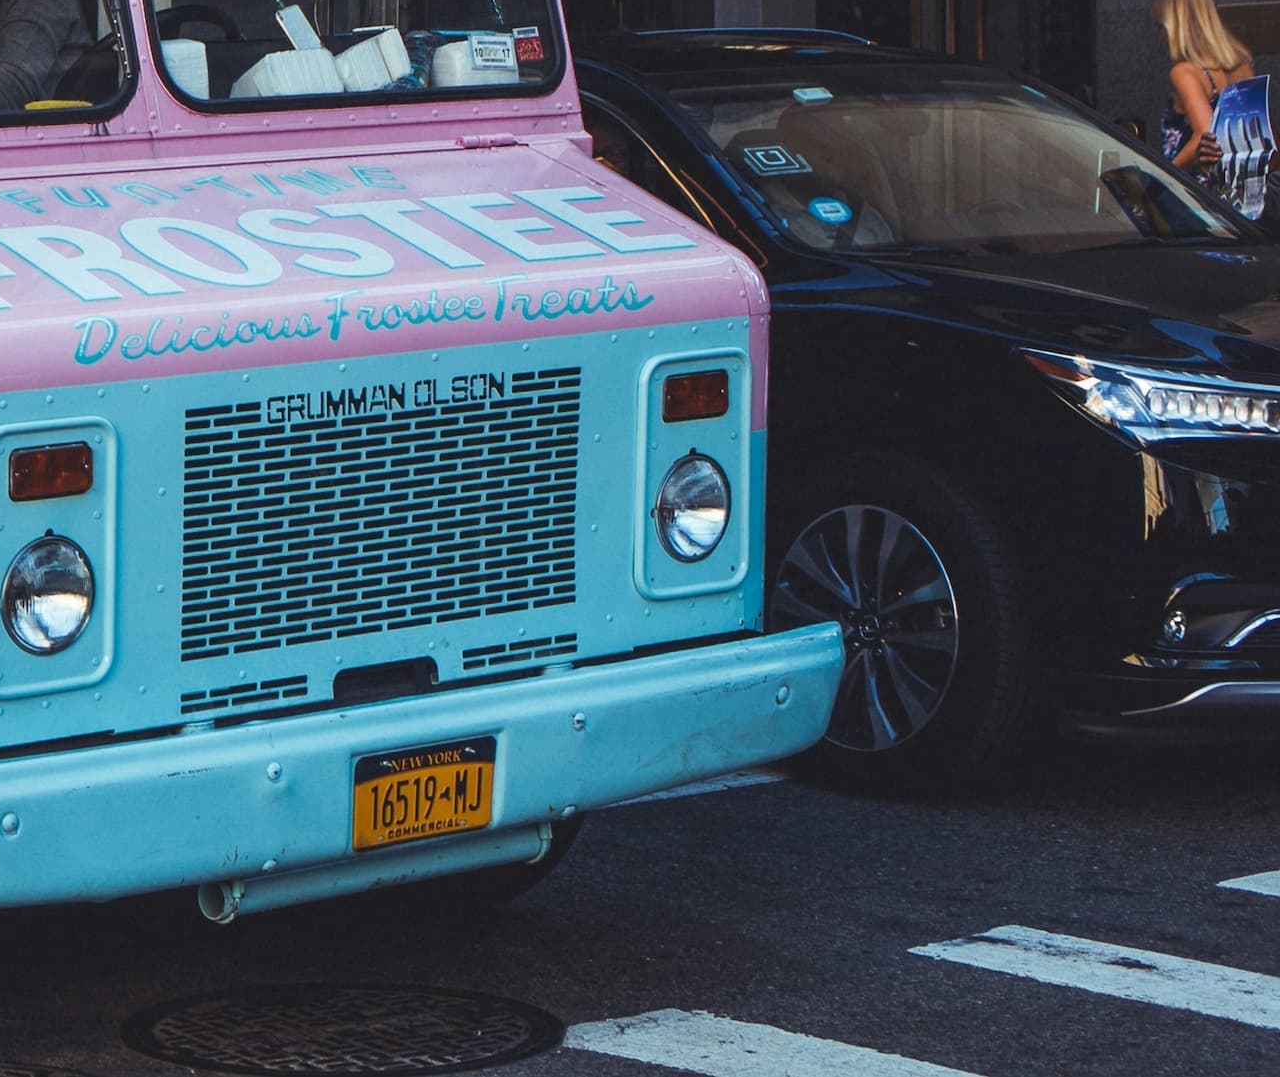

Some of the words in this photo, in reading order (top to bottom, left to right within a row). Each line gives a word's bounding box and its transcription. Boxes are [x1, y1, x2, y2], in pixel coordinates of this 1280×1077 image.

[502, 48, 511, 58] 17
[72, 312, 324, 365] Delicious
[324, 286, 487, 341] Frostee
[491, 272, 655, 318] Treats
[267, 382, 405, 424] GRUMMAN
[414, 371, 505, 407] OLSON
[390, 754, 425, 773] NEW
[426, 748, 462, 766] YORK
[387, 817, 461, 840] COMMERCIAL
